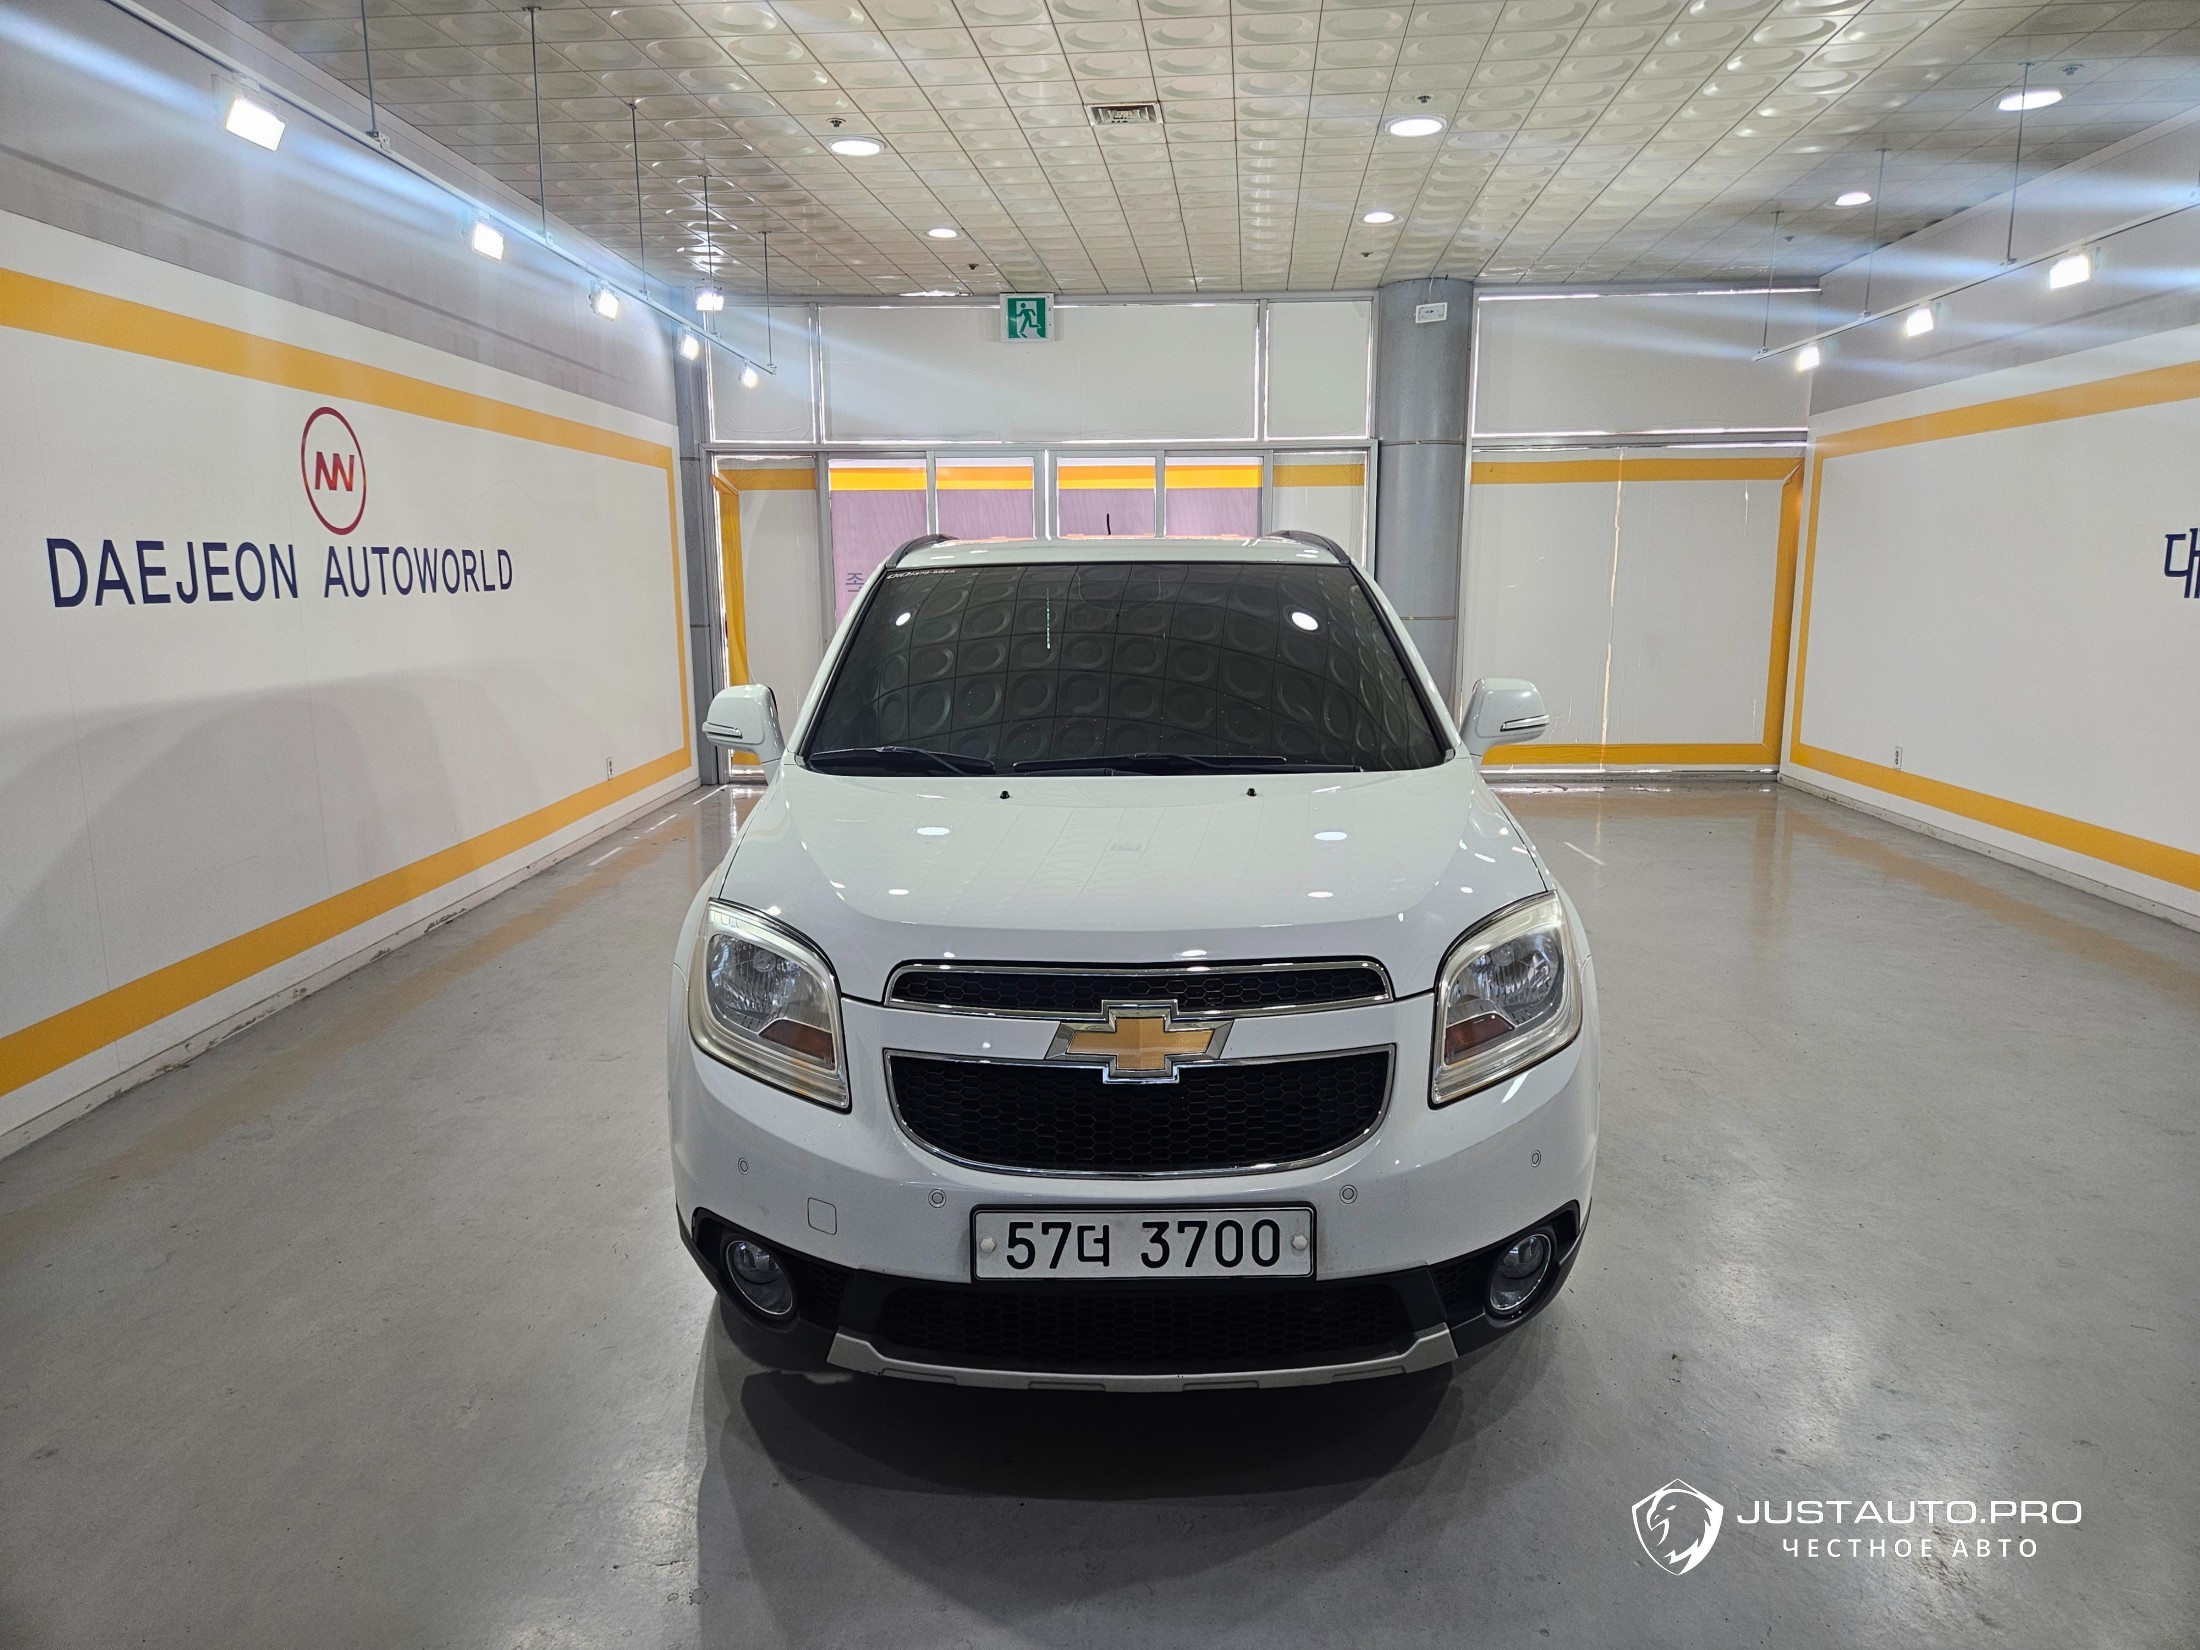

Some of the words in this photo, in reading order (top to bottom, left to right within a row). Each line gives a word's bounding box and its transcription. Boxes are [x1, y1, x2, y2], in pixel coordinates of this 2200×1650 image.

[46, 538, 299, 608] DAEJEON
[323, 545, 514, 599] AUTOWORLD
[1006, 1220, 1110, 1270] 57더
[1140, 1218, 1281, 1269] 3700
